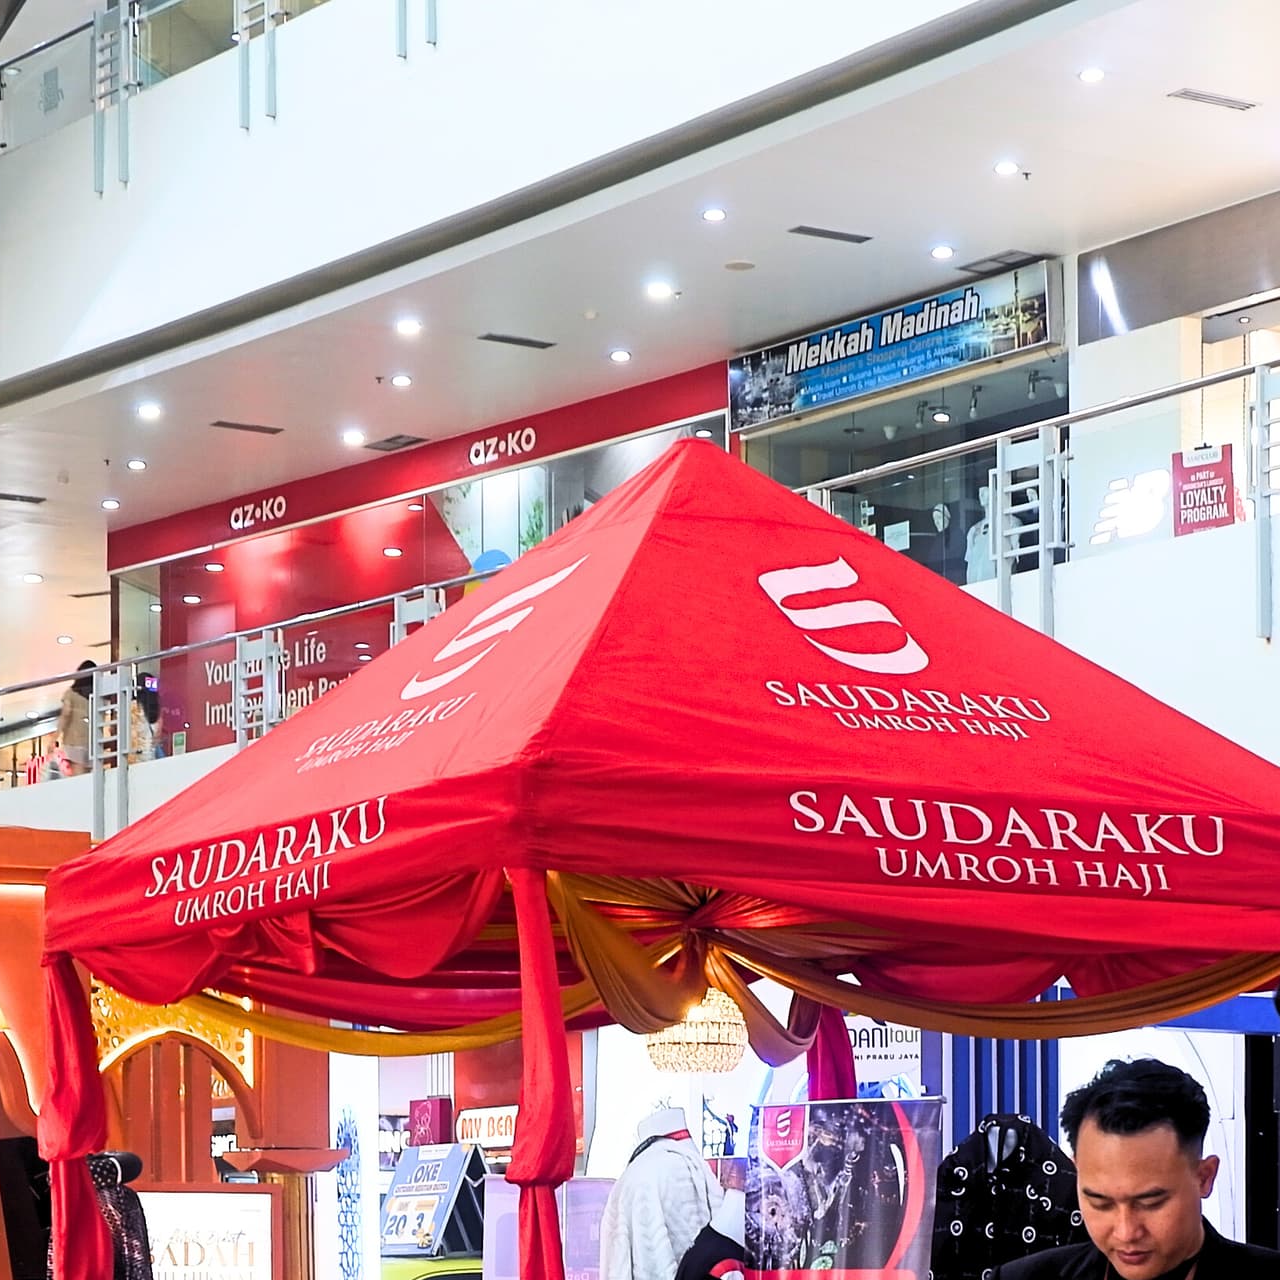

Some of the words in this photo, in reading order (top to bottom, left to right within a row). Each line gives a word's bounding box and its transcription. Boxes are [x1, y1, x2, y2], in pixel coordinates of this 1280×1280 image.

[786, 322, 873, 375] Mekkah
[880, 288, 980, 347] Madinah
[1180, 485, 1227, 509] LOYALTY
[295, 638, 327, 667] Life
[296, 692, 476, 761] SAUDARAKU
[765, 680, 1051, 724] SAUDARAKU
[834, 710, 954, 735] UMROH
[965, 717, 1031, 742] HAJI
[145, 796, 388, 898] SAUDARAKU
[789, 790, 1225, 858] SAUDARAKU
[175, 879, 265, 928] UMROH
[274, 861, 331, 902] HAJI
[875, 846, 1059, 887] UMROH
[1078, 860, 1172, 897] HAJI
[461, 1118, 482, 1139] MY
